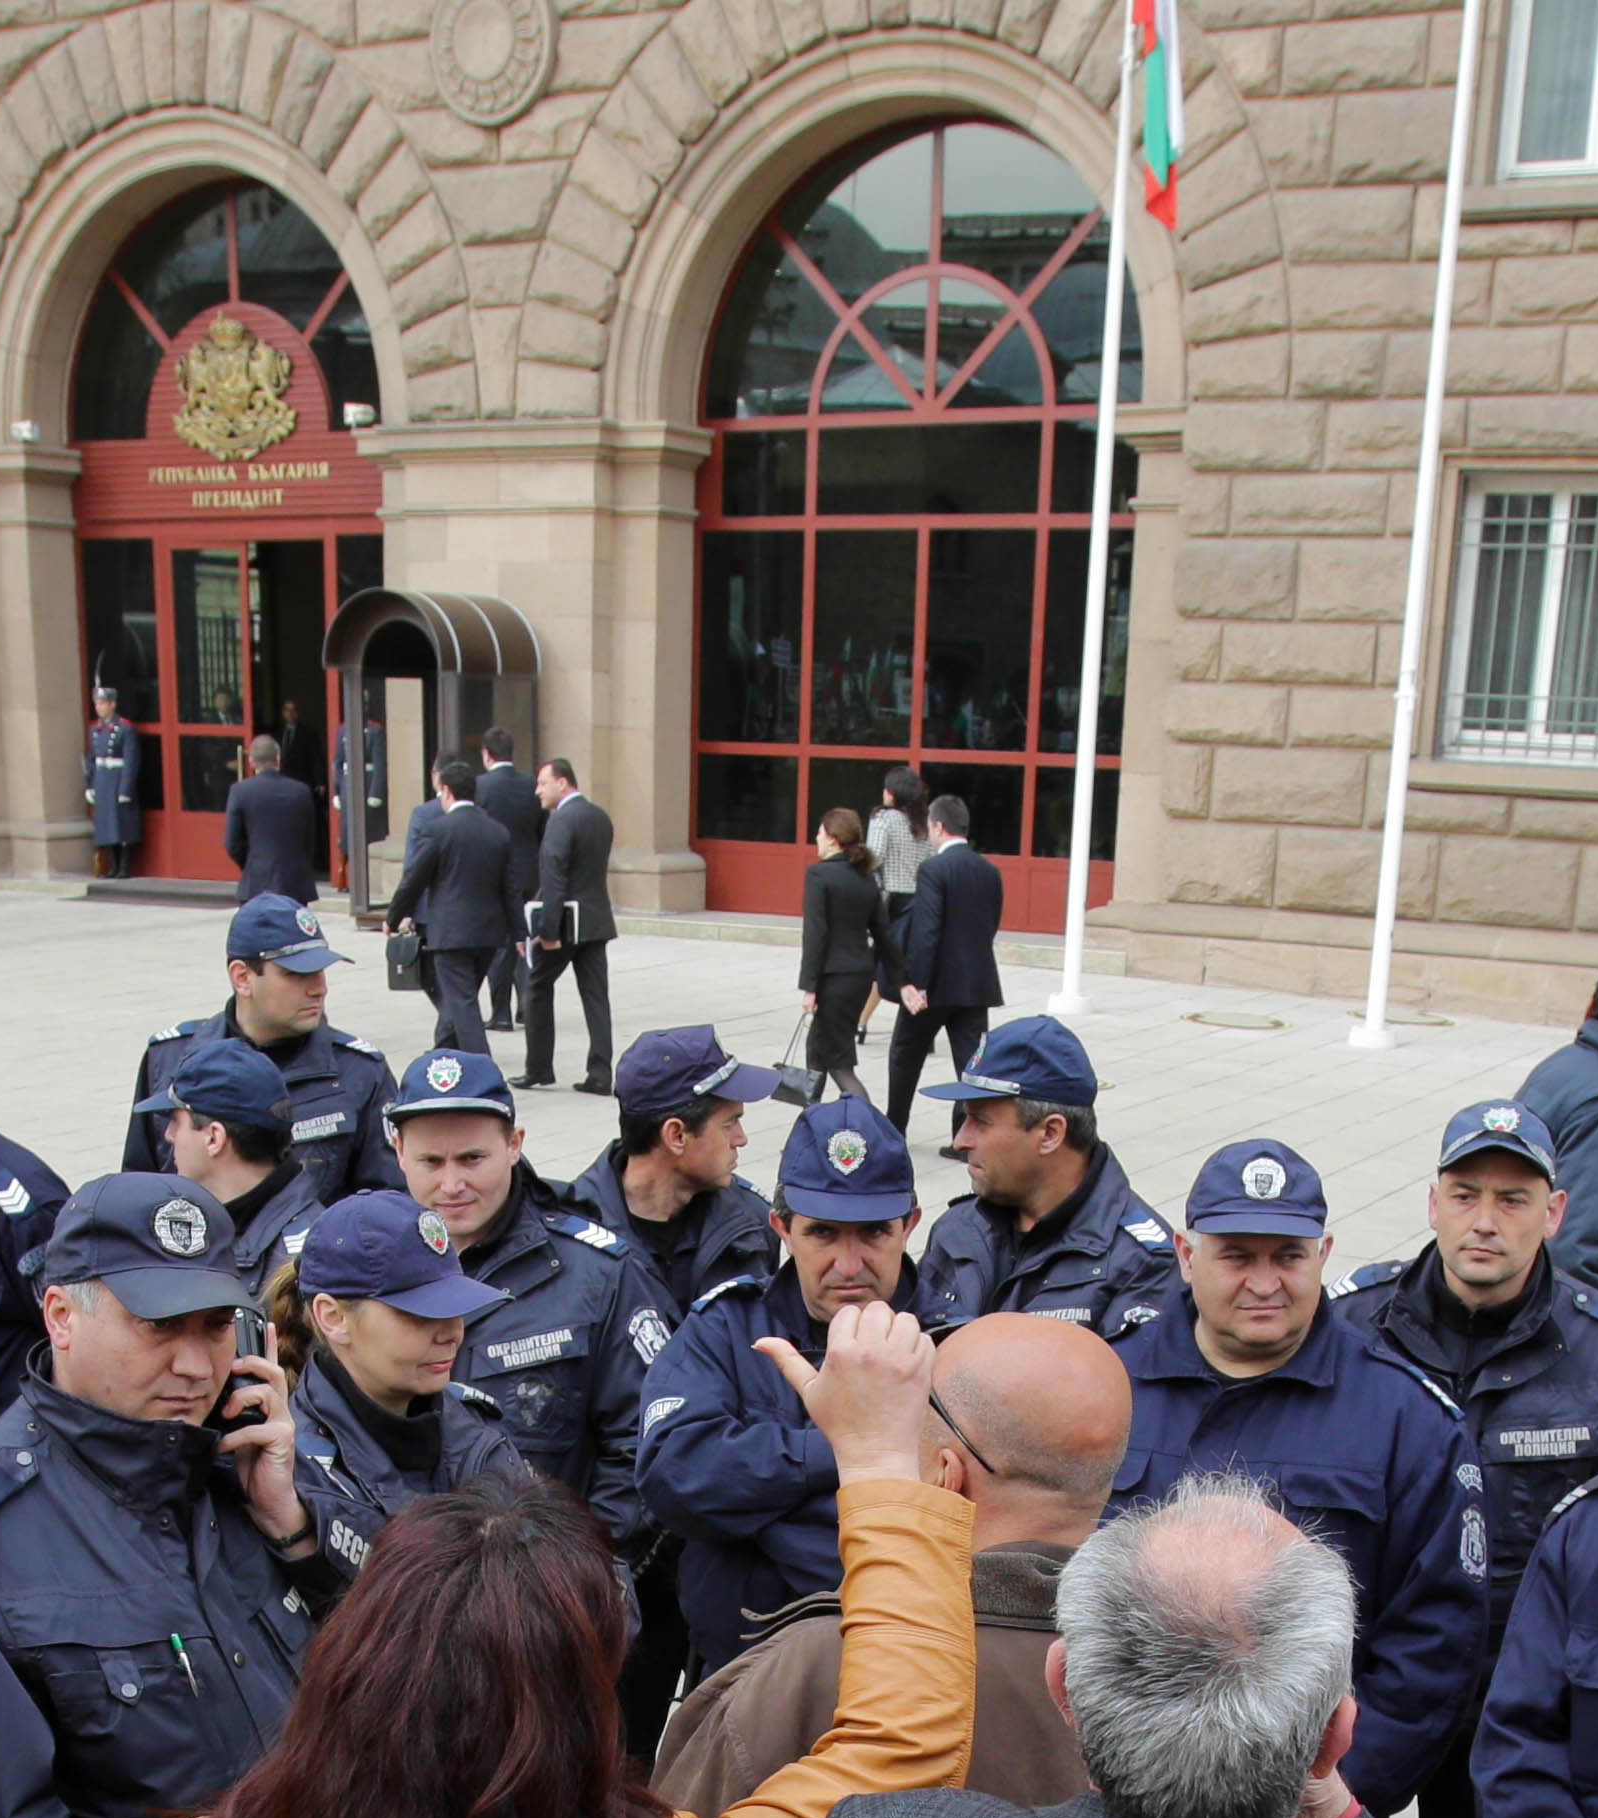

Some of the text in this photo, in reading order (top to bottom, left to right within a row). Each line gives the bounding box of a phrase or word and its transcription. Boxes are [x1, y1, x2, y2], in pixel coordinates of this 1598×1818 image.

[148, 461, 330, 484] РЕПУБЛИКА БЪЛГАРИЯ
[192, 488, 284, 509] ПРЕЗИДЕНТ
[487, 1328, 573, 1359] ОХРАНИТЕЛНА
[503, 1343, 562, 1368] ПОЛИЦИЯ
[1500, 1427, 1590, 1445] ОХРАНИТЕЛНА
[1514, 1441, 1576, 1457] ПОЛИЦИЯ
